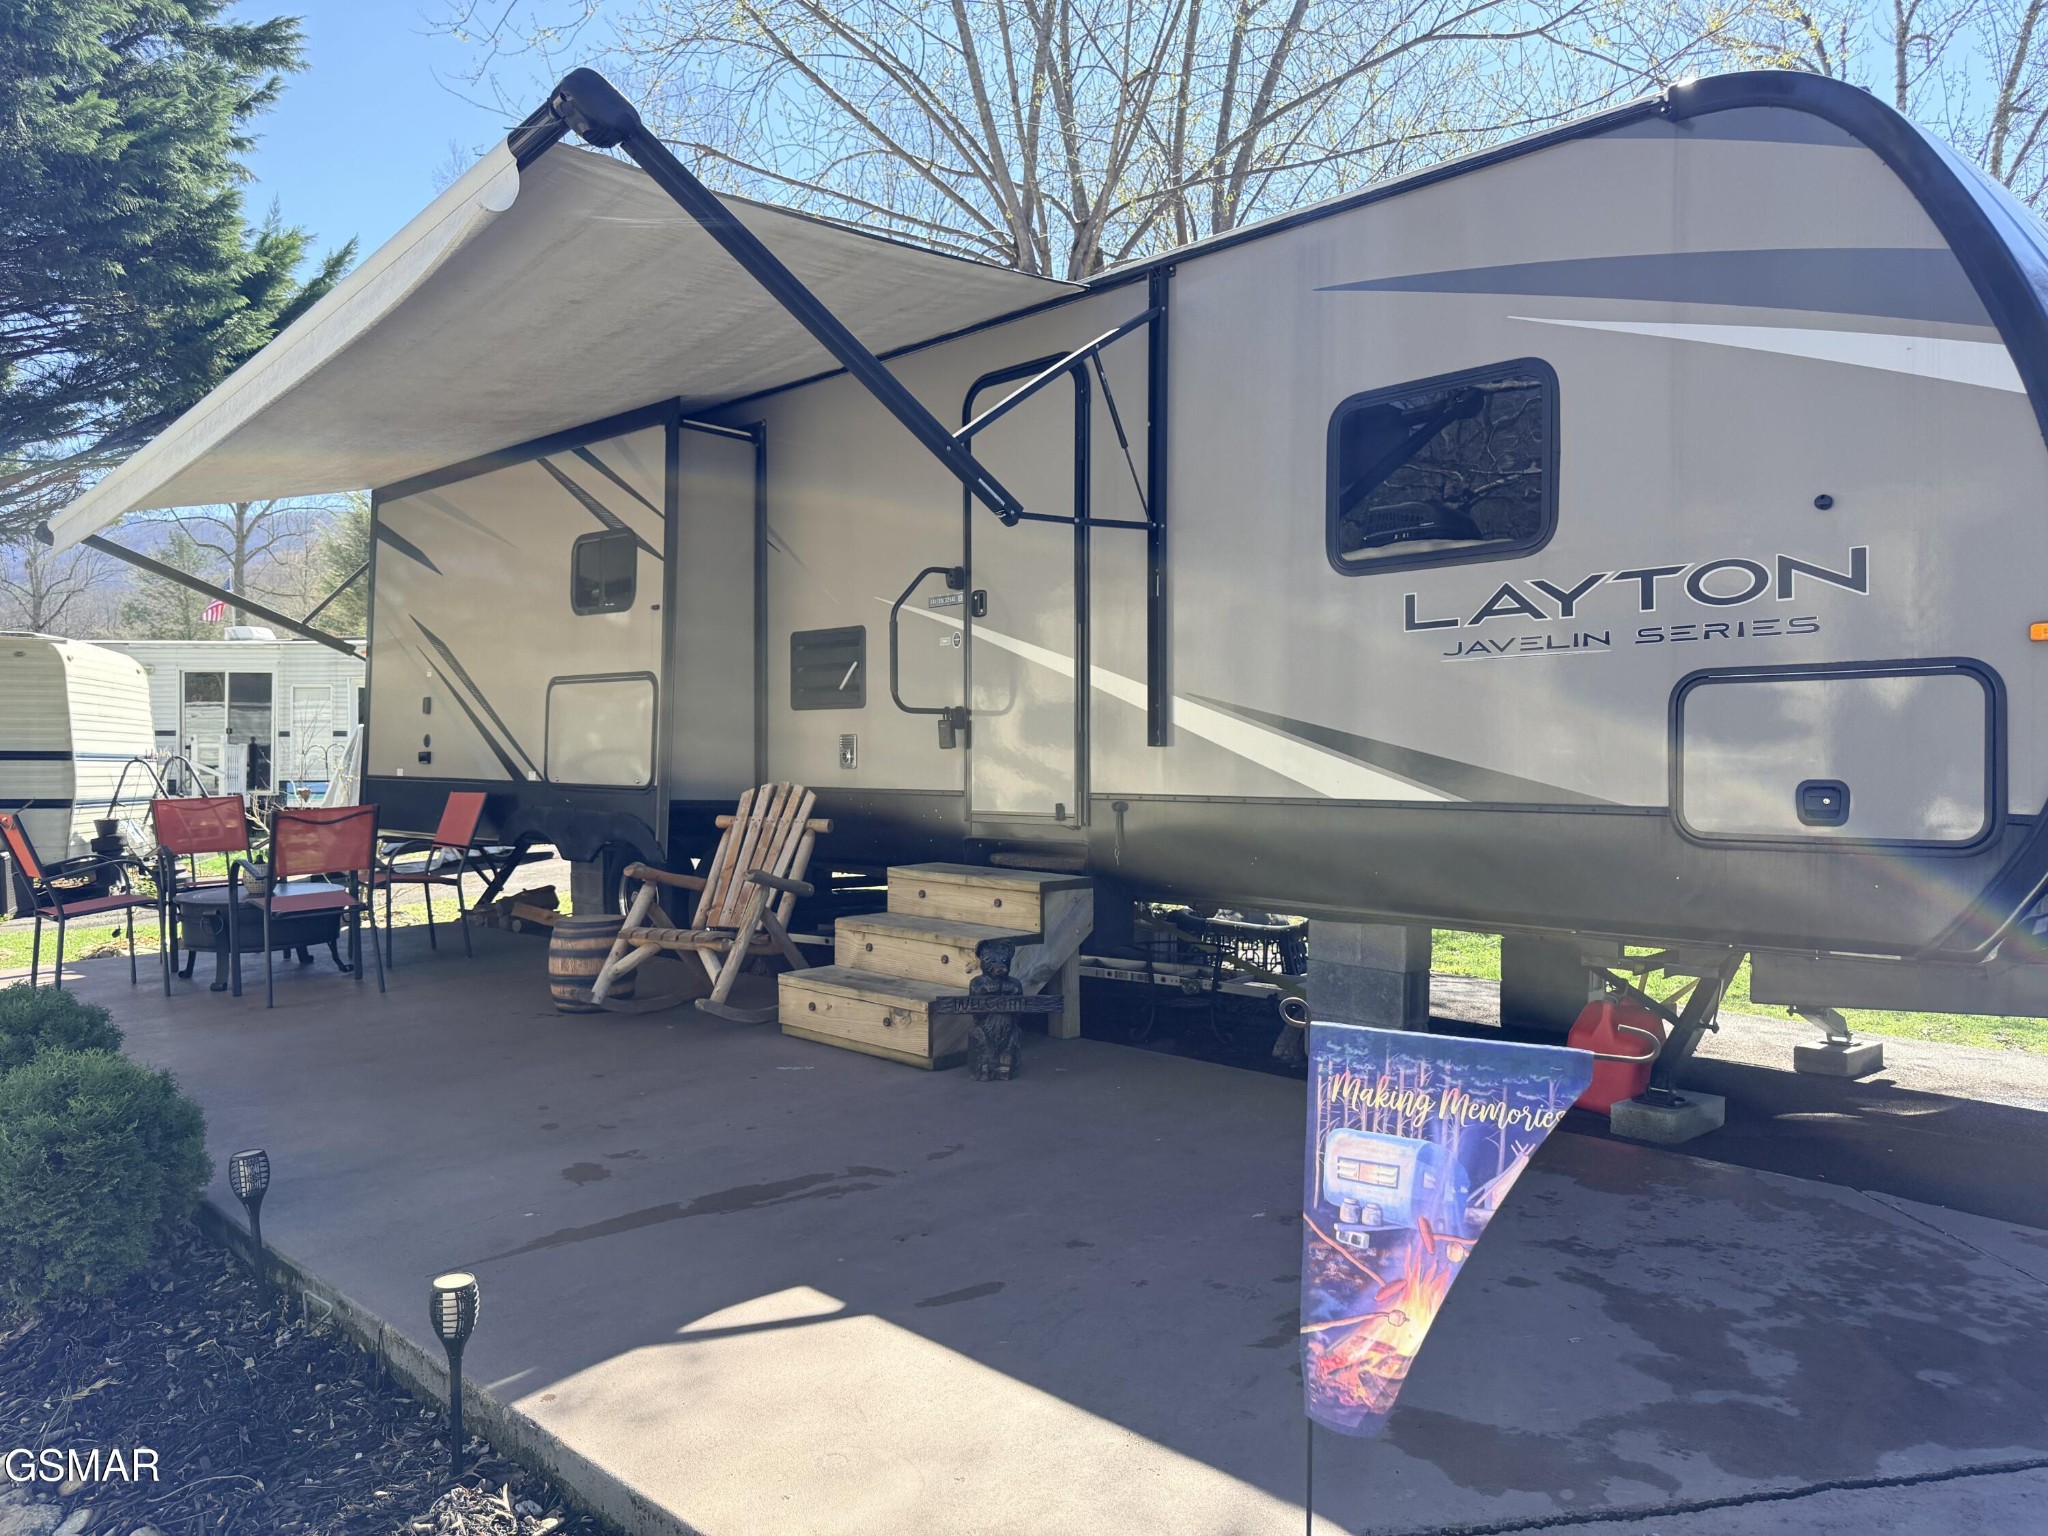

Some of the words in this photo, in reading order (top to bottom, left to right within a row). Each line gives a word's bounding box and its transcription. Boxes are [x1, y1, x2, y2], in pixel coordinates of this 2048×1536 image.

[1403, 545, 1869, 632] LAYTON
[1443, 630, 1611, 657] JAVELIN
[1635, 616, 1821, 644] SERIES
[1330, 1070, 1435, 1127] Making
